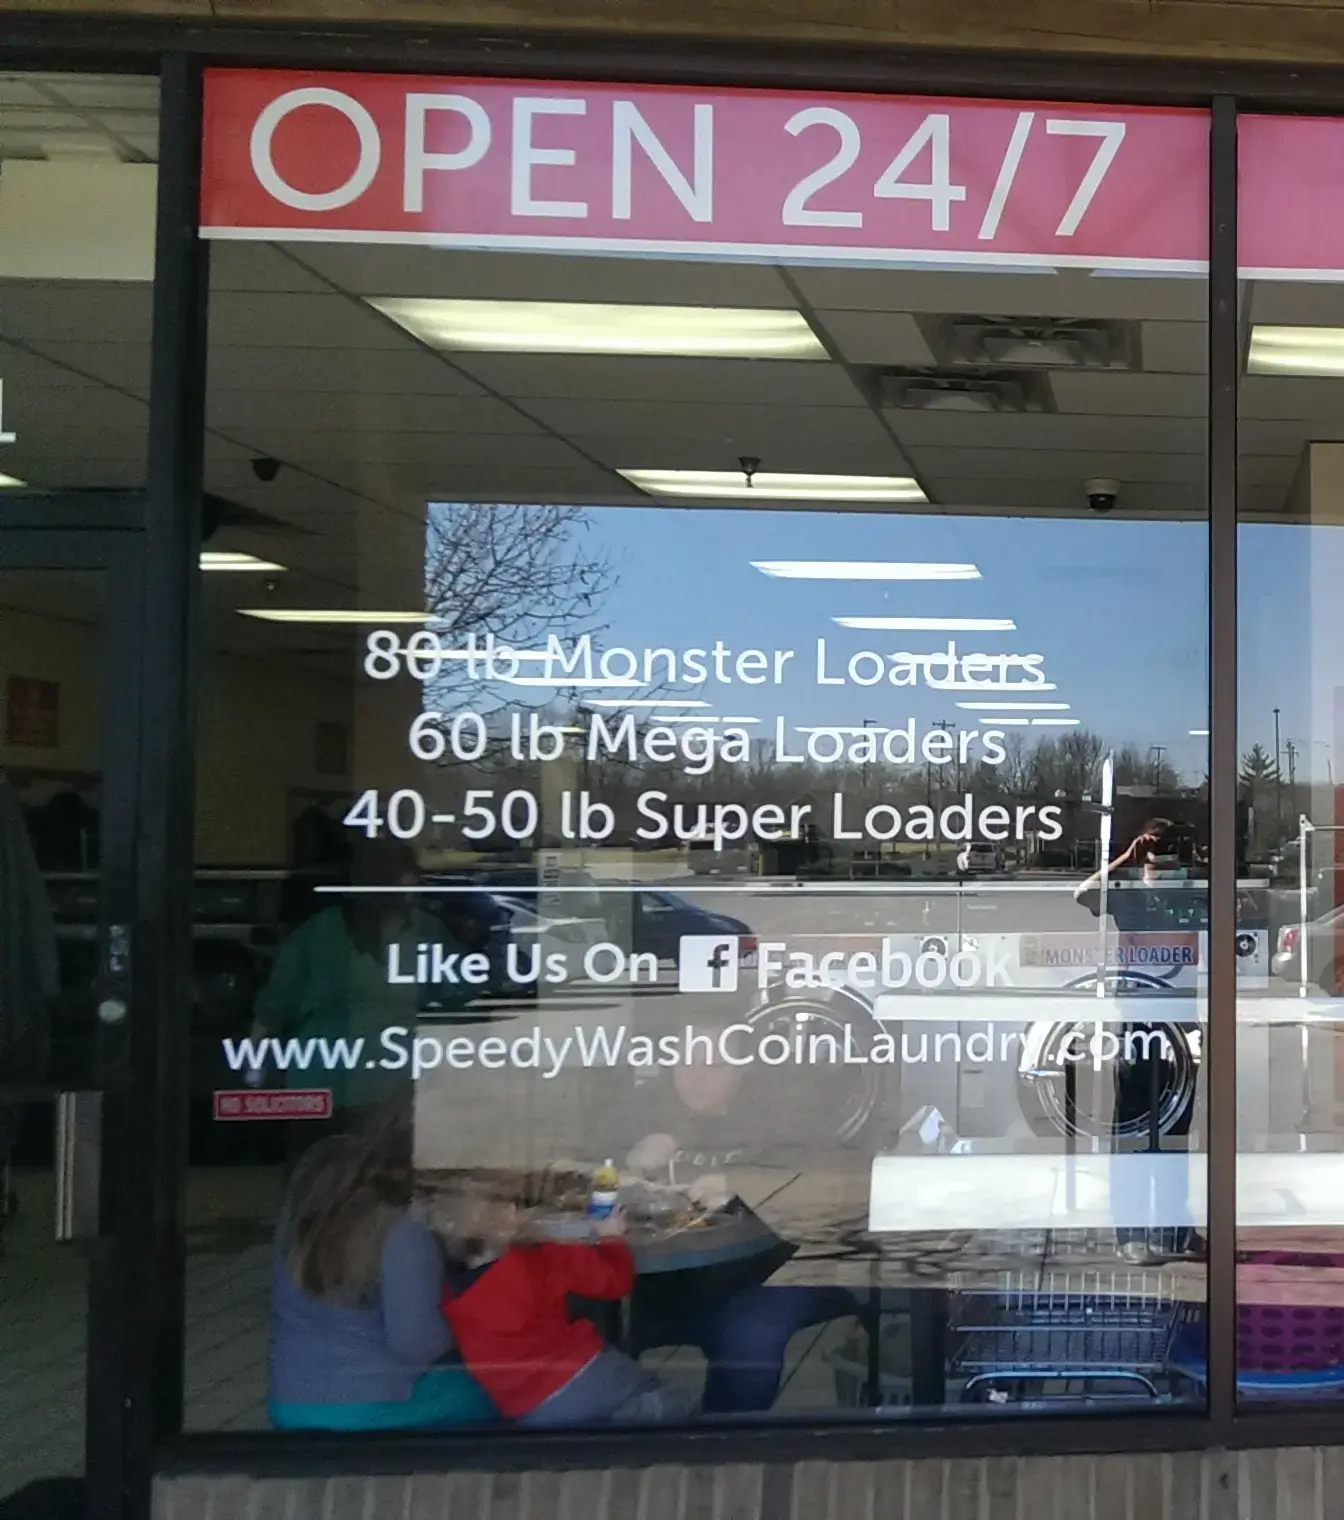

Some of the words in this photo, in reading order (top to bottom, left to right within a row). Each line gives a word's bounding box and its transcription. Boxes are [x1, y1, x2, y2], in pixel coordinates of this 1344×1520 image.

[250, 87, 714, 223] OPEN
[781, 107, 1127, 240] 24/7
[364, 631, 442, 680] 80
[465, 632, 520, 680] lb
[543, 634, 794, 684] Monster
[817, 638, 1046, 687] Loaders
[409, 712, 487, 762] 60
[511, 713, 565, 762] lb
[587, 714, 750, 775] Mega
[776, 717, 1007, 764] Loaders
[343, 789, 538, 839] 40-50
[561, 791, 615, 839] lb
[636, 791, 812, 851] Super
[834, 793, 1063, 841] Loaders
[387, 943, 490, 984] Like
[506, 943, 567, 983] Us
[584, 943, 658, 982] On
[757, 939, 1014, 990] Facebook
[1045, 945, 1126, 965] MONSER
[1129, 946, 1194, 964] LOADER
[223, 1022, 1168, 1079] www.SpeedyWashCoinLaundry.com
